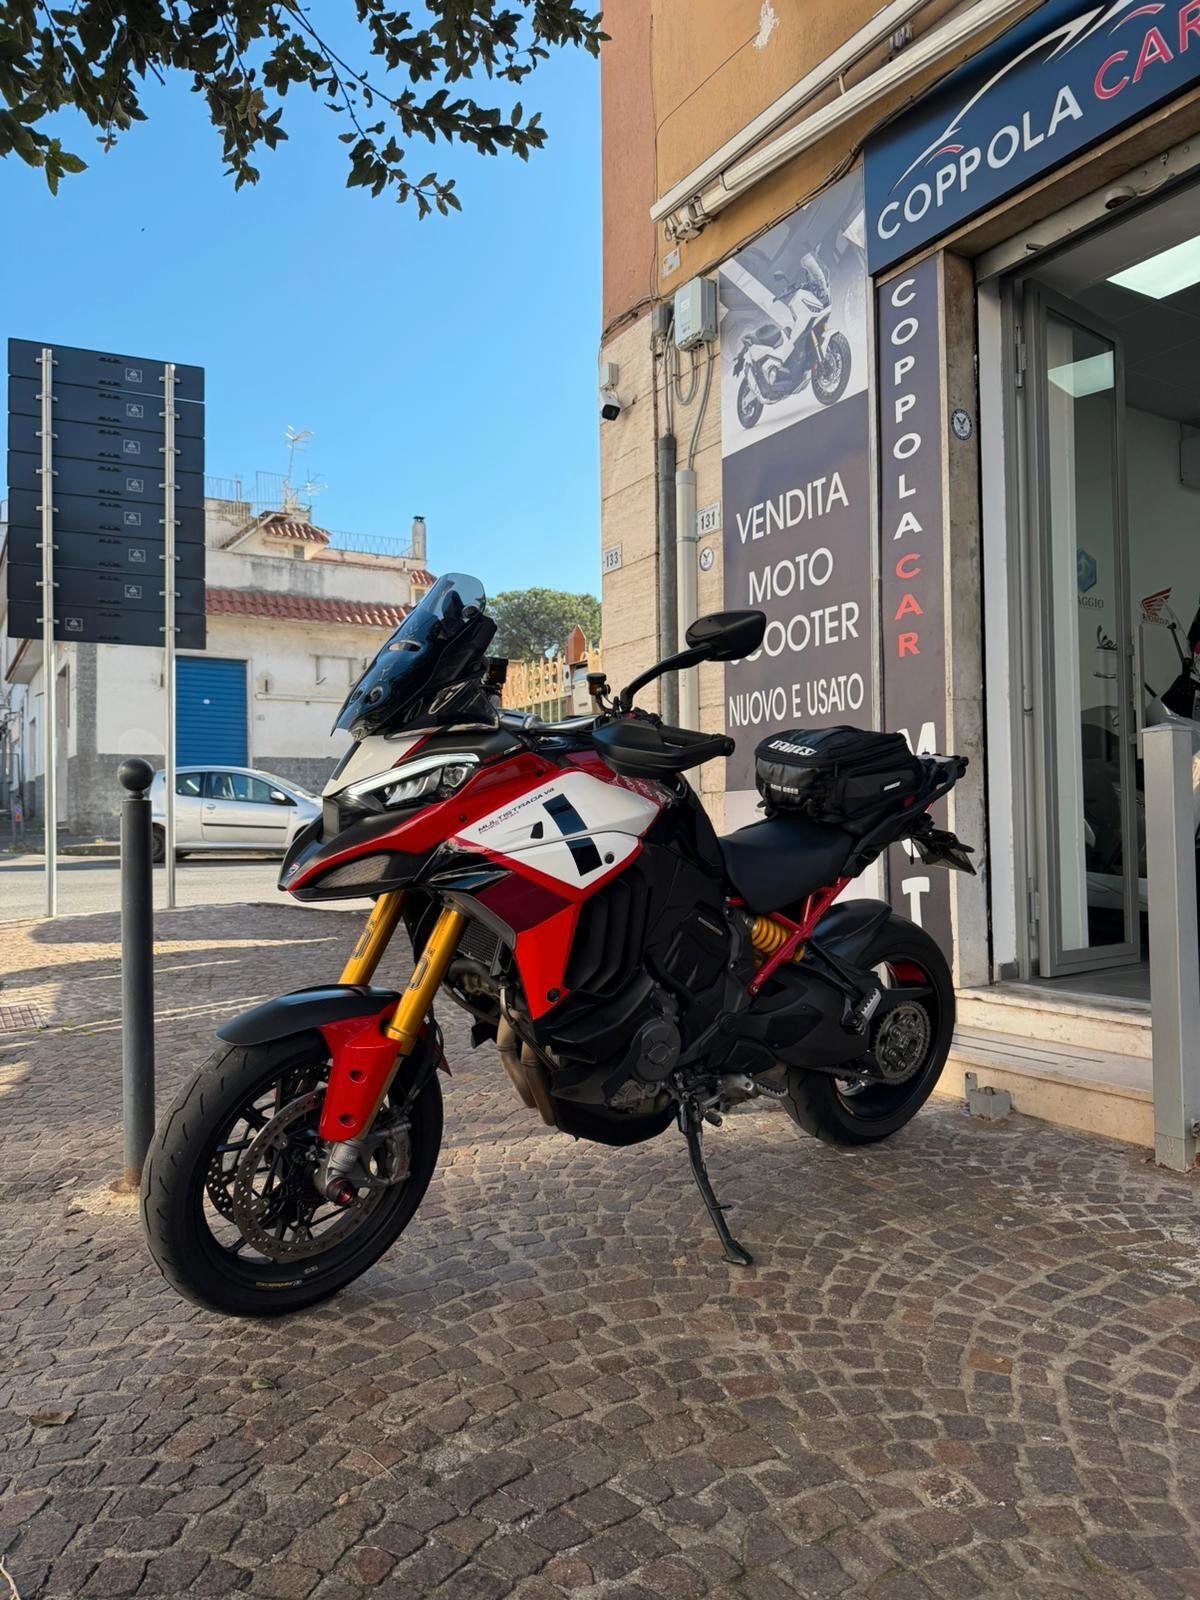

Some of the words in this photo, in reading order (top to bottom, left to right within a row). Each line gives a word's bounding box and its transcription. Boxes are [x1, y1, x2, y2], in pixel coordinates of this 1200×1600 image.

[877, 85, 1084, 240] COPPOLA
[701, 511, 715, 530] 131
[736, 472, 849, 544] VENDITA
[606, 551, 619, 568] 133
[748, 547, 834, 606] MOTO
[729, 601, 860, 666] OOTER
[729, 686, 787, 728] NUOVO
[792, 683, 802, 718] E
[807, 672, 864, 716] USATO
[478, 794, 543, 832] MULTISTRADA
